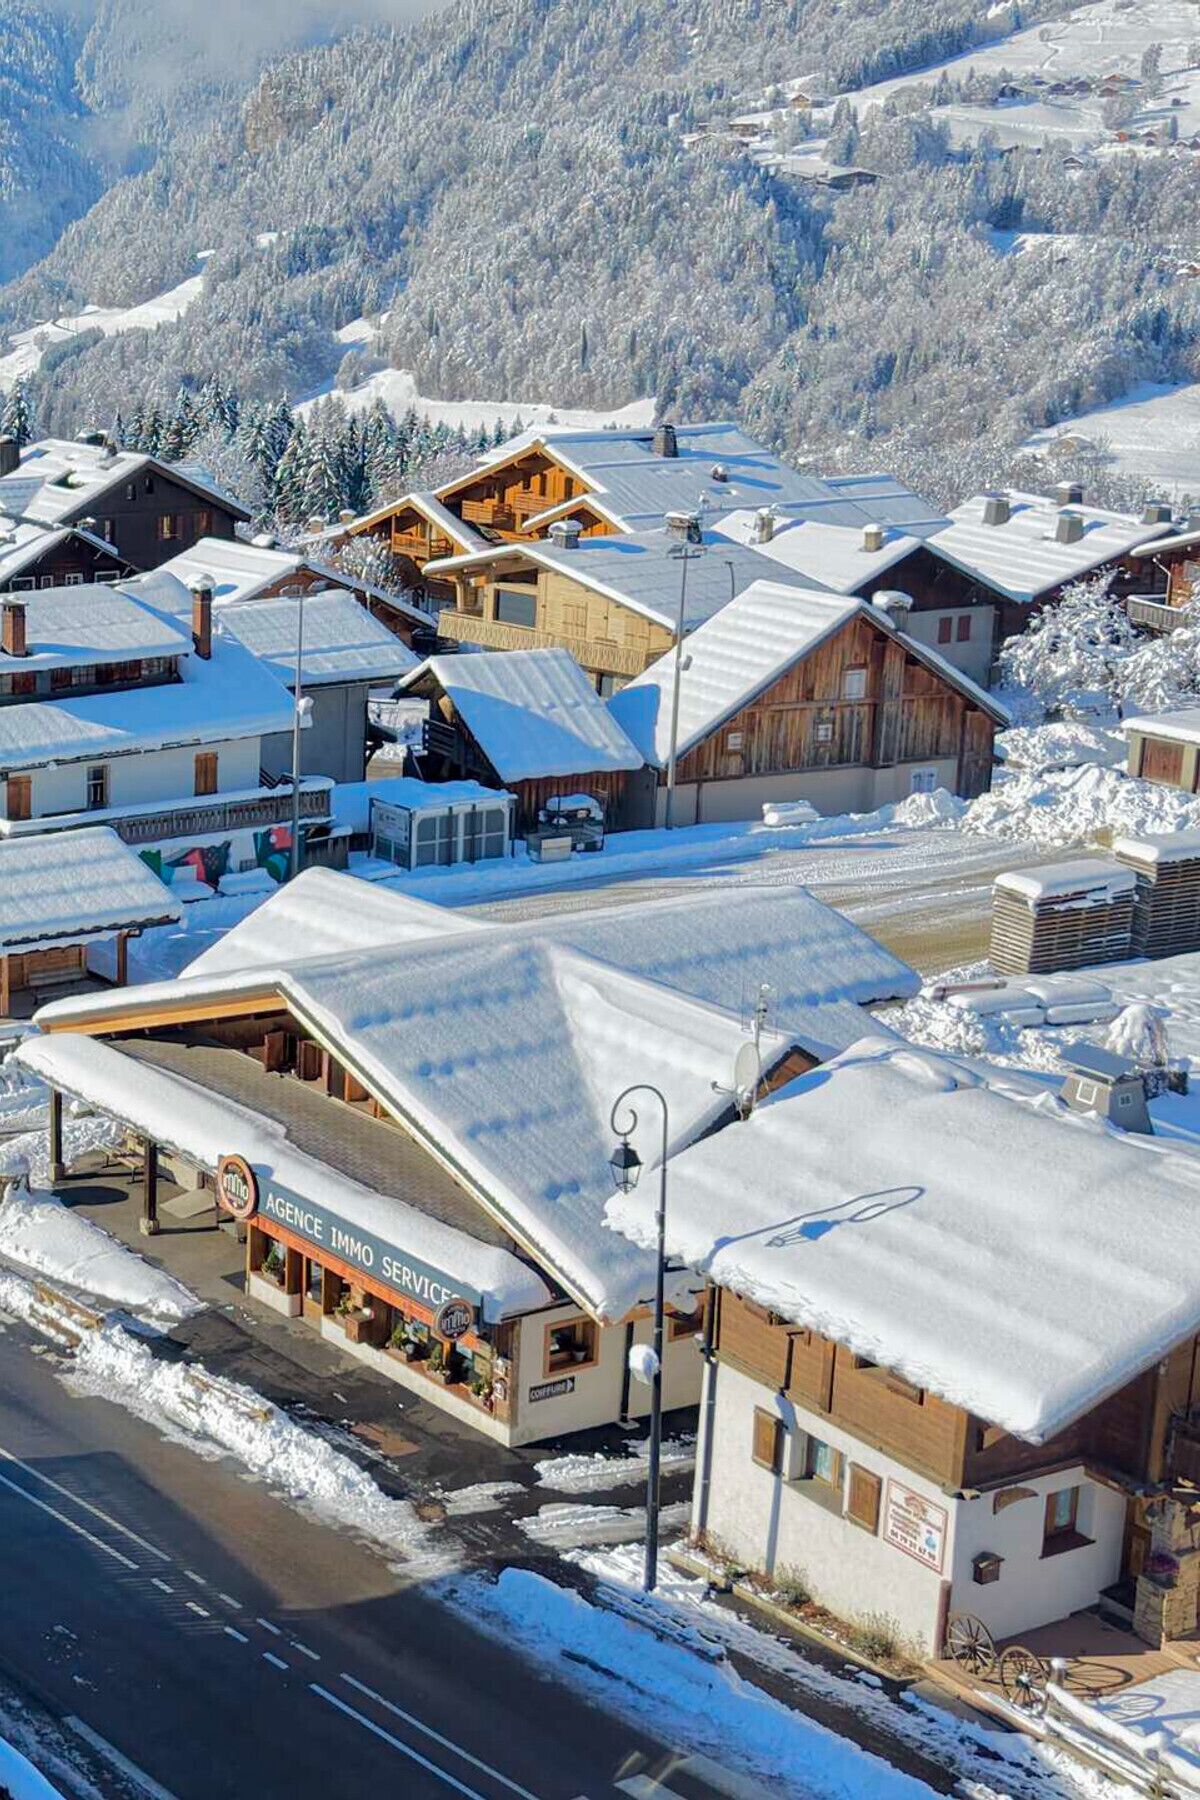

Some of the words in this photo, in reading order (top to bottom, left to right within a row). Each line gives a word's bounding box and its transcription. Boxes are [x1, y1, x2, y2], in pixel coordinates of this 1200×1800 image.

[265, 1192, 323, 1240] AGENCE
[330, 1226, 373, 1267] IMMO
[381, 1256, 460, 1304] SERVICE
